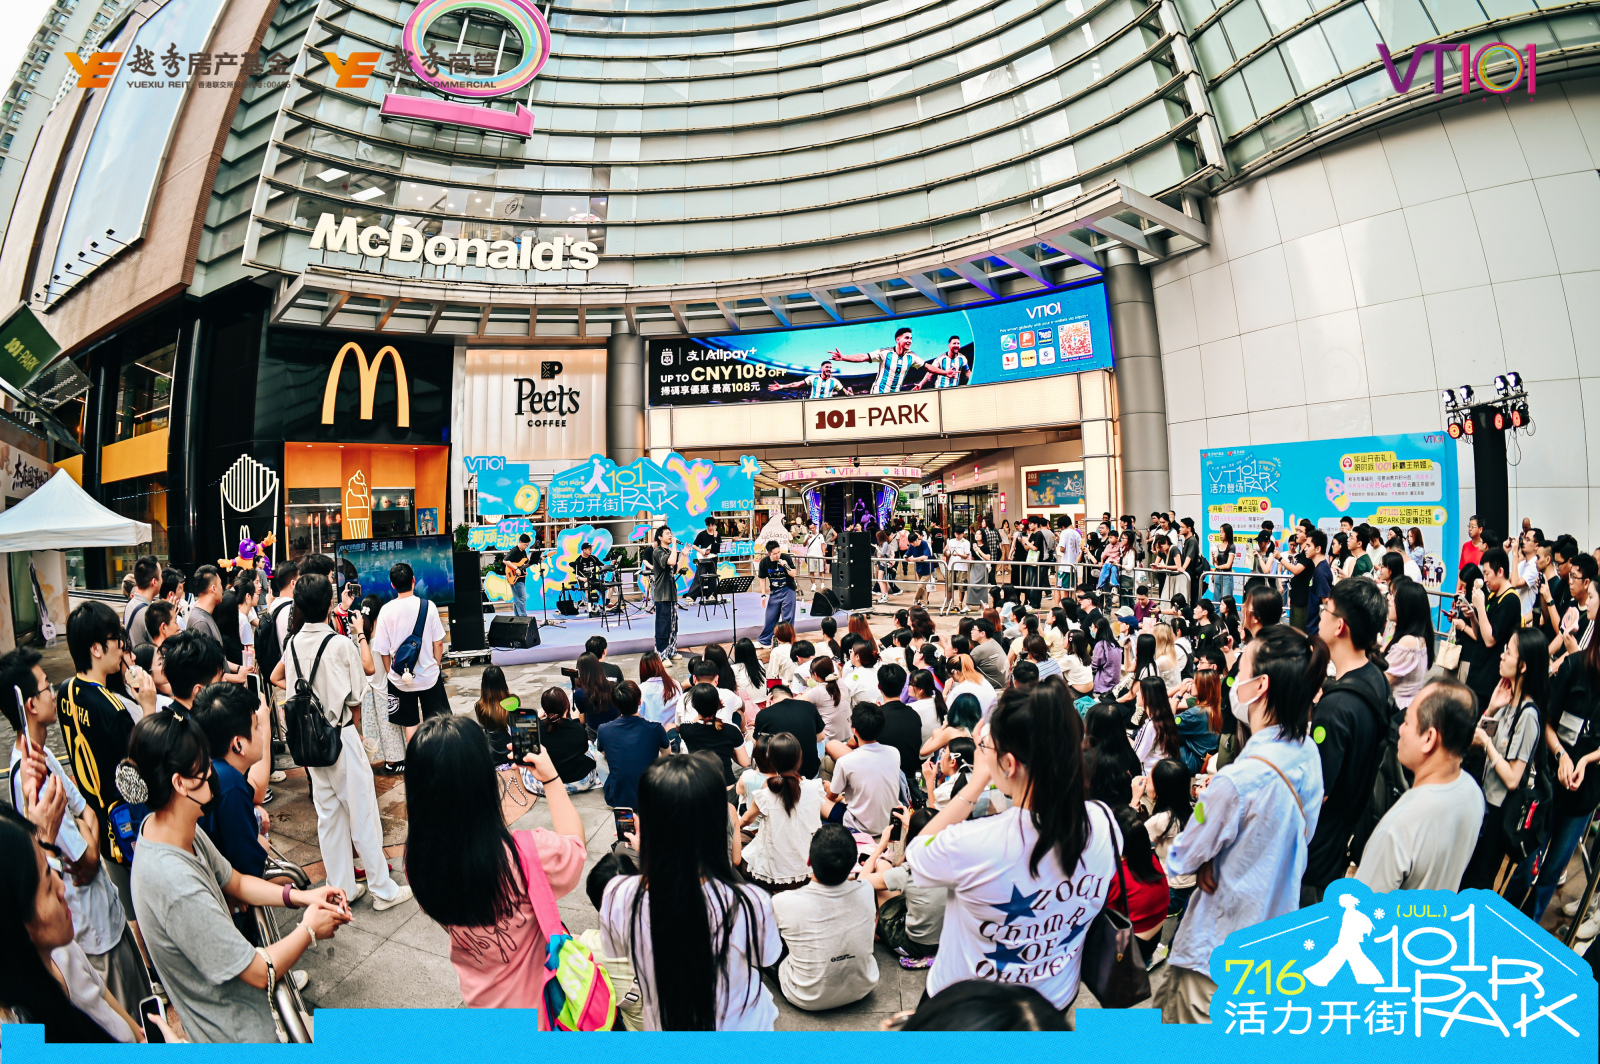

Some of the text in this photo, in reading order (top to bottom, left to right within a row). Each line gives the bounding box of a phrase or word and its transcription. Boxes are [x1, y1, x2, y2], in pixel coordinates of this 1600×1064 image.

[308, 212, 599, 271] McDonald's
[1026, 301, 1061, 319] VT101
[706, 347, 757, 361] Alipay+
[660, 363, 787, 383] UP TO CNY 108 OFF
[513, 378, 580, 416] Peet's
[527, 419, 567, 427] COFFEE
[815, 402, 929, 429] 101-PARK
[466, 457, 504, 471] VT101
[606, 462, 647, 496] 101
[552, 498, 618, 513] 活力开街
[574, 492, 601, 500] Opening
[619, 480, 679, 512] PARK
[498, 520, 530, 534] 101+
[61, 698, 91, 727] CUHA
